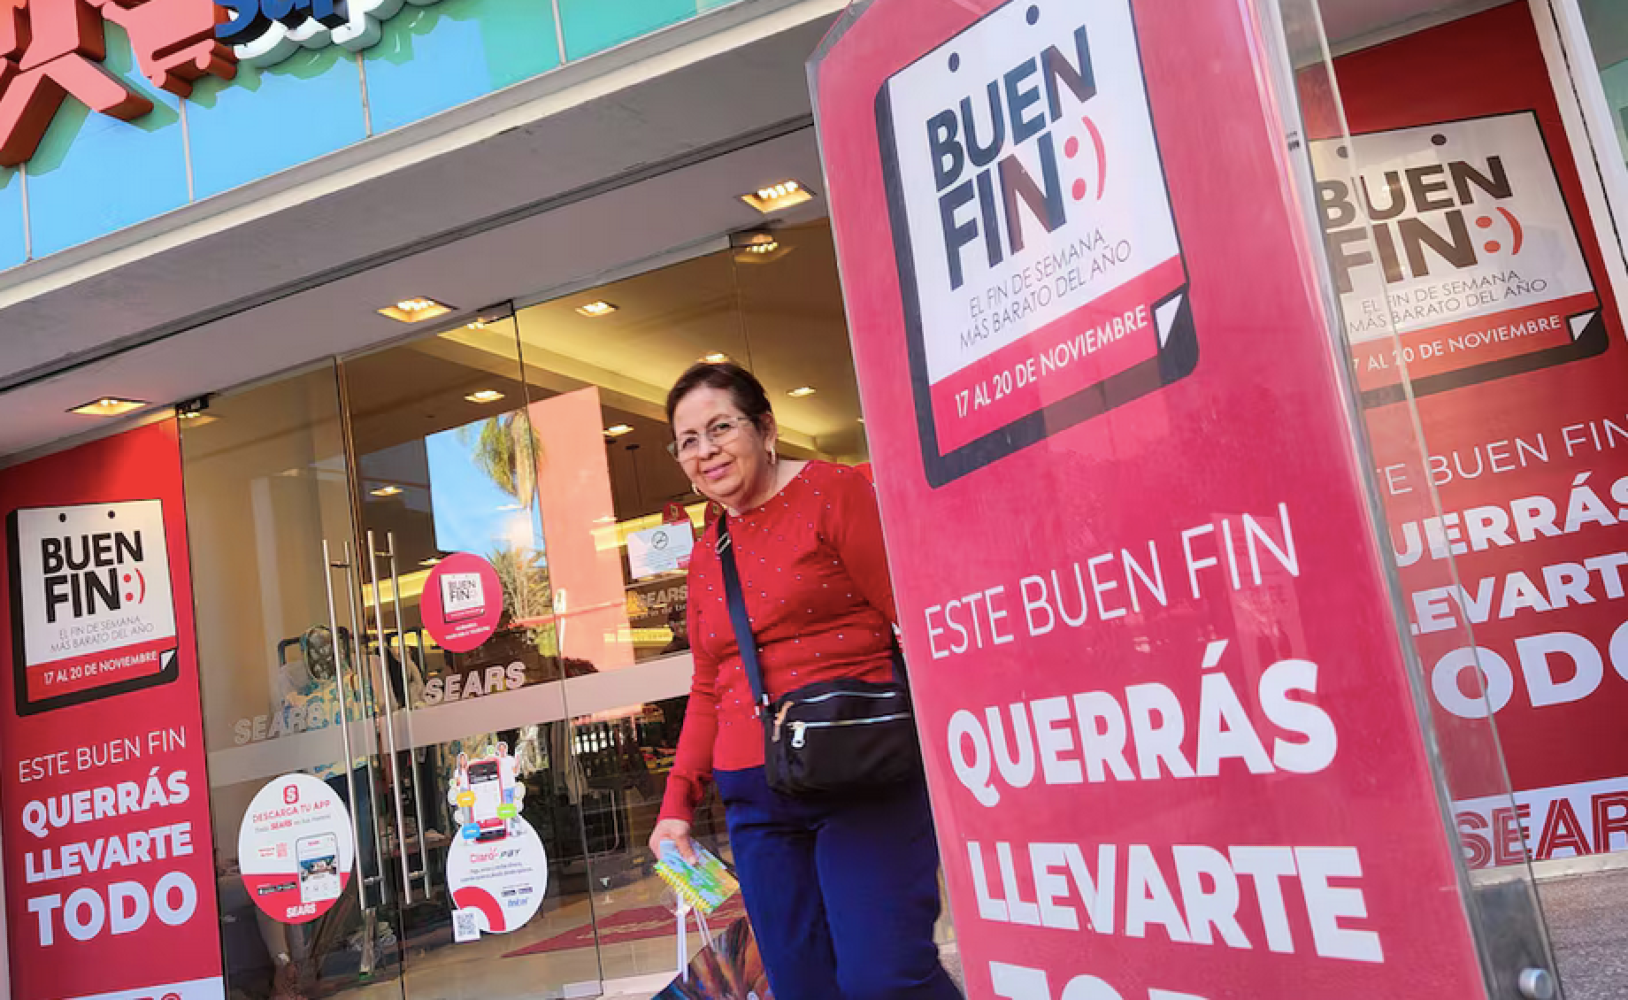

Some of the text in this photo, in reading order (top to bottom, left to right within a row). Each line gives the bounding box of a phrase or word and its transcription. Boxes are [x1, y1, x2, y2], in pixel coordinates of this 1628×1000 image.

[926, 24, 1097, 193] BUEN
[1316, 155, 1513, 229] BUEN
[960, 239, 1131, 349] MÁS BARATO DEL AÑO
[970, 229, 1106, 318] EL FIN DE SEMANA
[1362, 300, 1378, 314] EL
[1414, 285, 1438, 303] DE
[1442, 270, 1521, 296] SEMANA
[1392, 298, 1461, 323] BARATO
[1466, 292, 1496, 308] DEL
[1504, 279, 1548, 299] AÑO
[955, 304, 1148, 418] 17 AL 20 DE NOVIEMBRE
[1367, 353, 1389, 372] AL
[1419, 341, 1444, 360] DE
[1448, 315, 1561, 353] NOVIEMBRE
[1429, 433, 1549, 486] BUEN
[41, 531, 144, 575] BUEN
[1392, 471, 1628, 567] UERRÁ
[924, 502, 1299, 660] ESTE BUEN FIN
[1410, 552, 1628, 636] EVART
[71, 626, 84, 636] FIN
[87, 624, 98, 635] DE
[100, 616, 140, 630] SEMANA
[73, 632, 109, 648] BARATO
[111, 629, 127, 640] DEL
[44, 650, 157, 685] 17 AL 20 DE NOVIEMBRE
[424, 661, 526, 704] SEARS
[1431, 620, 1628, 719] OD
[18, 726, 187, 783] ESTE BUEN FIN
[234, 702, 324, 745] SEARS
[947, 639, 1337, 808] QUERRÁS
[22, 766, 190, 838] QUERRÁS
[1455, 791, 1628, 870] SEAR
[25, 822, 193, 883] LLEVARTE
[27, 871, 197, 946] TODO
[967, 841, 1384, 963] LLEVARTE
